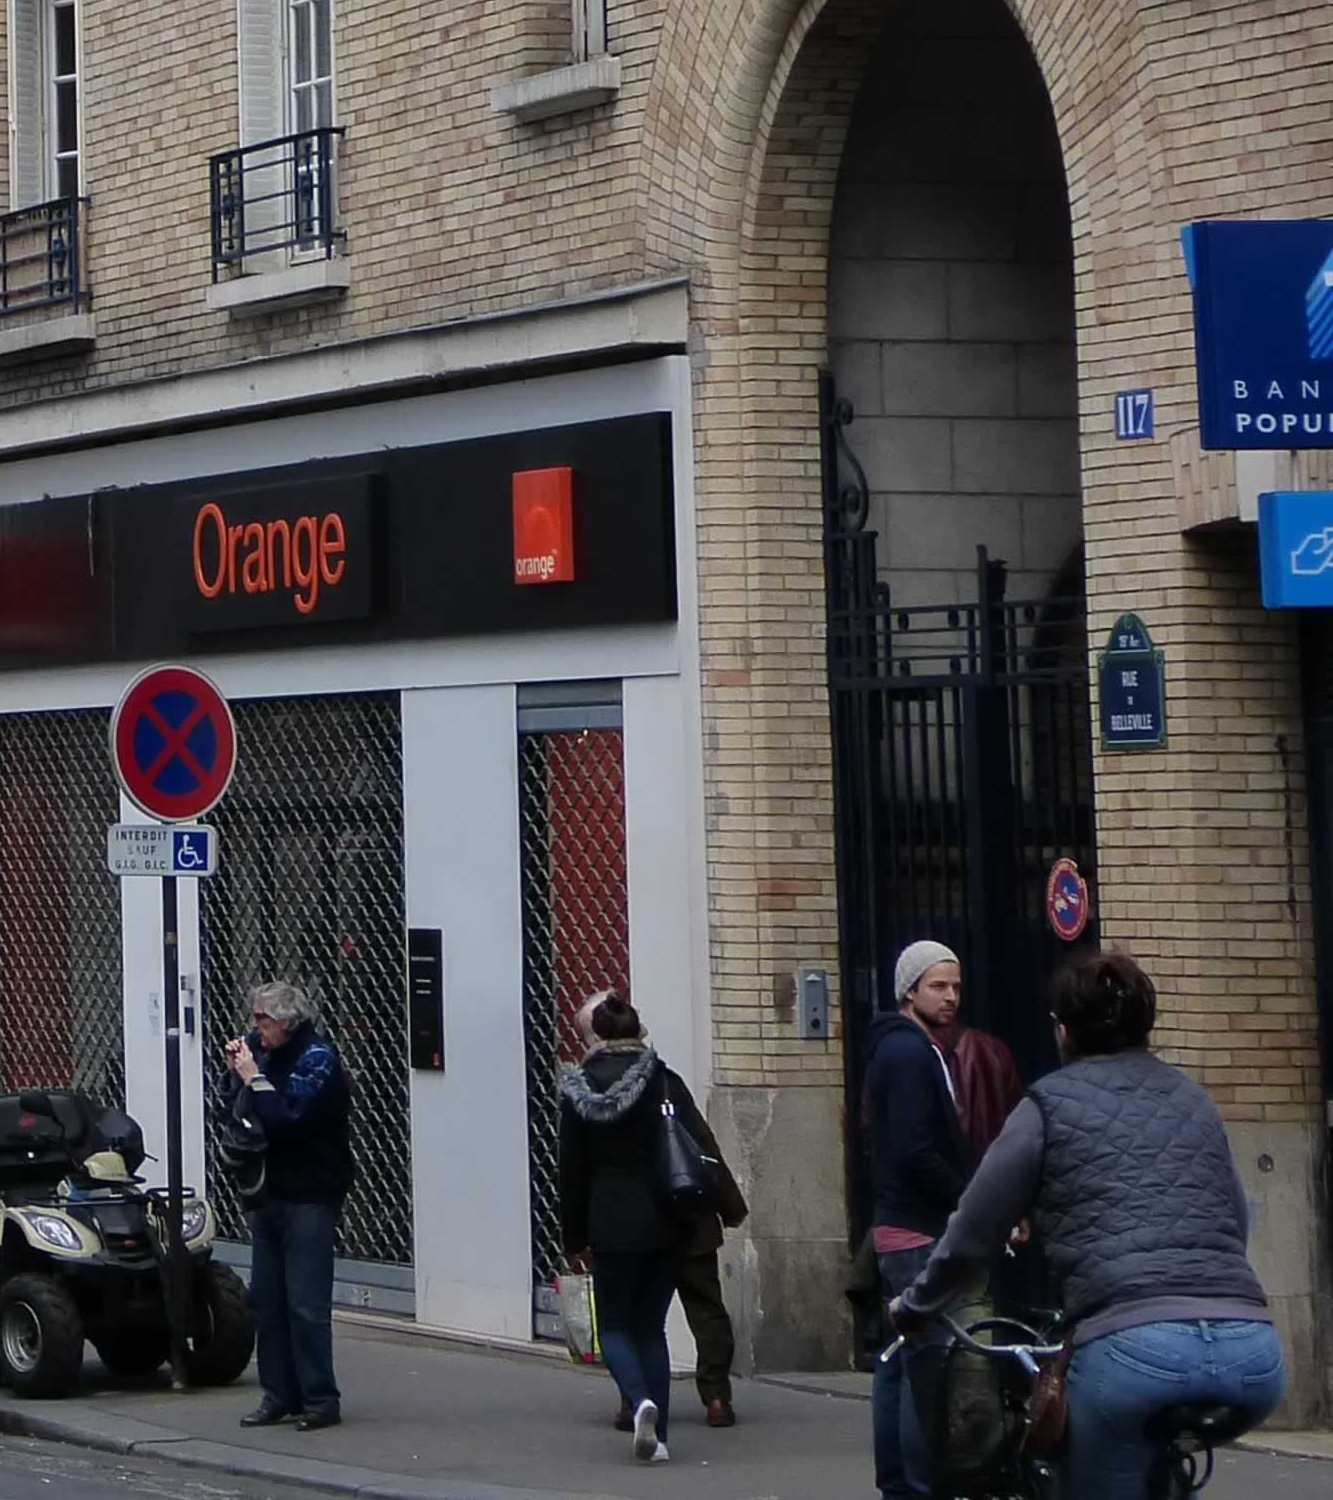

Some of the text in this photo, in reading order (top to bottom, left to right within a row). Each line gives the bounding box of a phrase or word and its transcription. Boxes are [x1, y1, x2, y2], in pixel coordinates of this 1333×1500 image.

[1117, 393, 1150, 436] 117
[193, 502, 346, 614] Orange
[1111, 713, 1153, 731] BELLEVILLE
[116, 830, 168, 841] INTERDIT
[127, 845, 157, 856] SAUF
